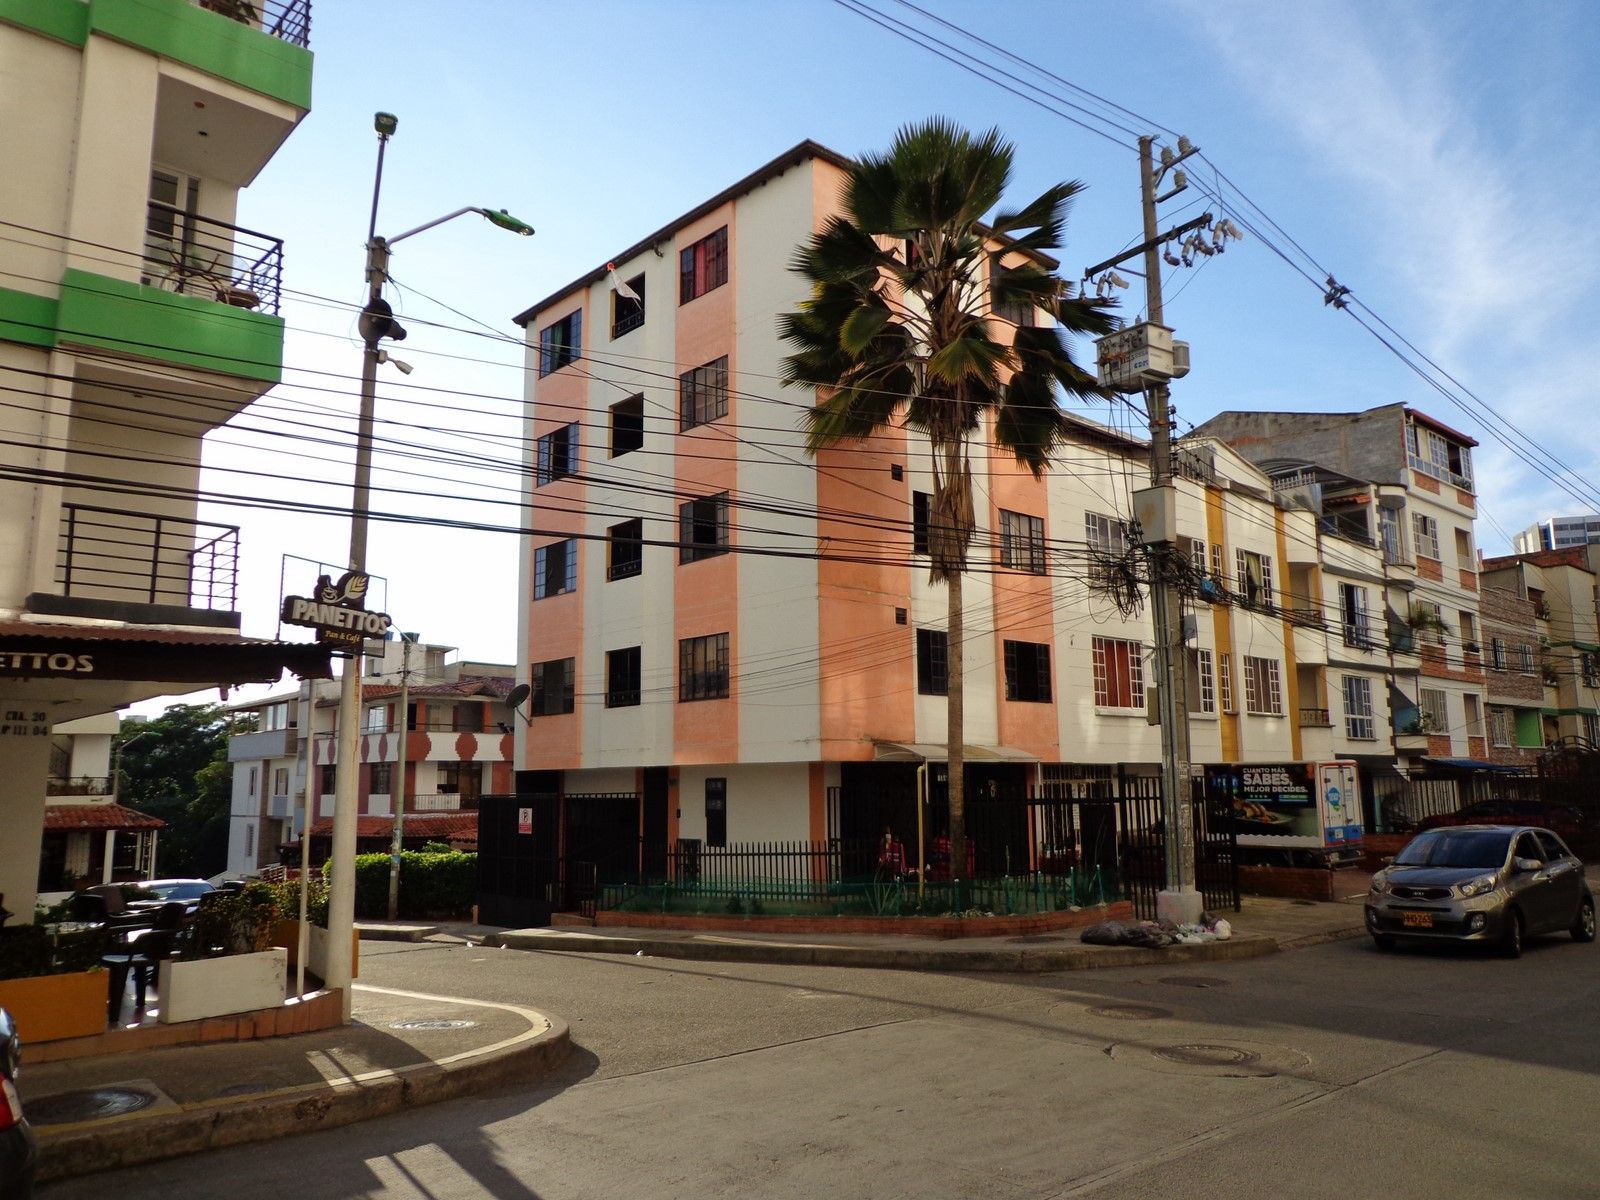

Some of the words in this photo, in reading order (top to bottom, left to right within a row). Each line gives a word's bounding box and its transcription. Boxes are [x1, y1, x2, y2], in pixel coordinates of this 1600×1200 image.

[292, 599, 390, 635] PANETTOS
[325, 630, 337, 639] Pan
[1243, 773, 1293, 786] SABES,
